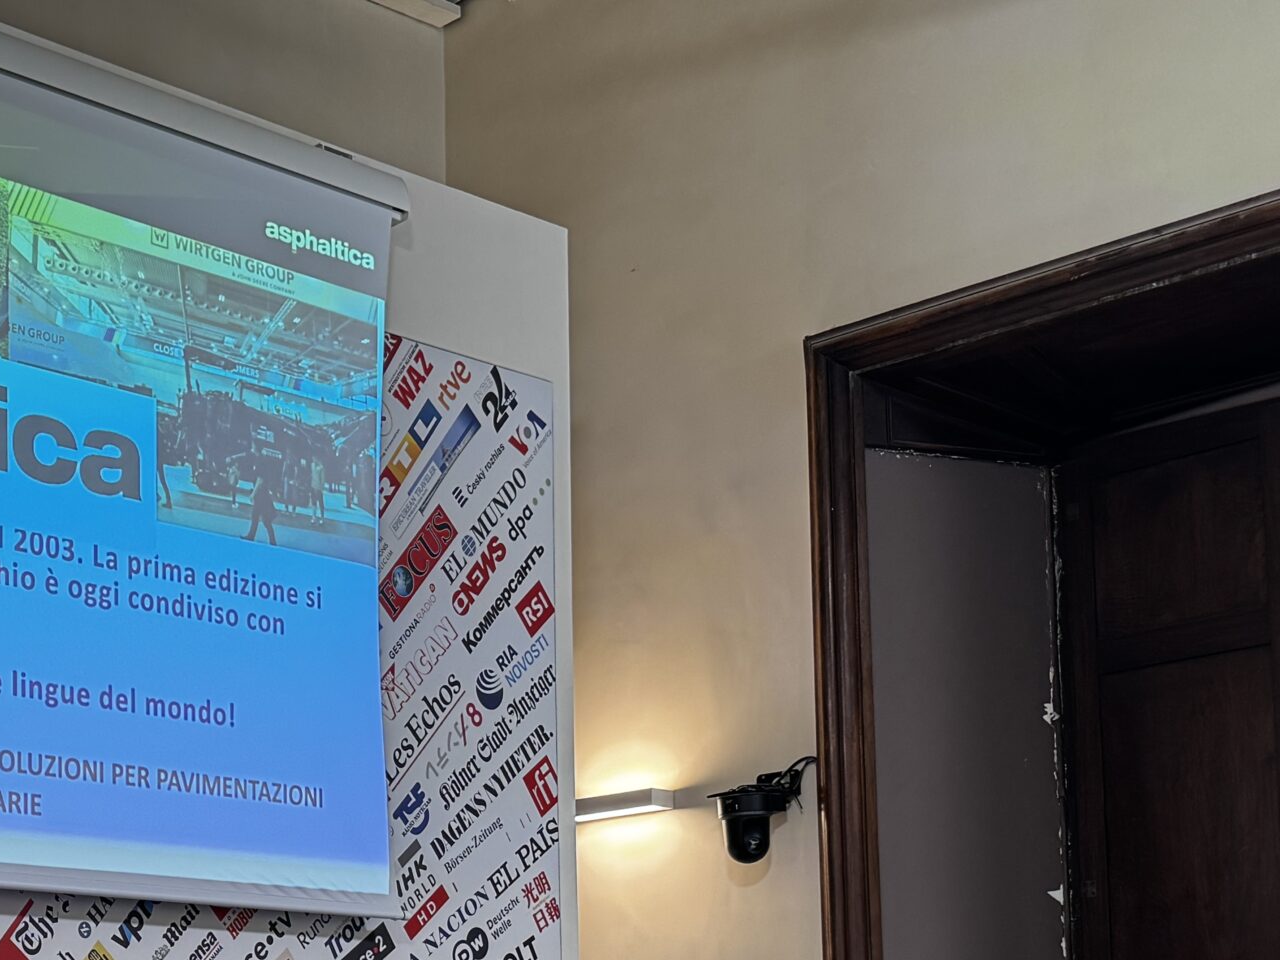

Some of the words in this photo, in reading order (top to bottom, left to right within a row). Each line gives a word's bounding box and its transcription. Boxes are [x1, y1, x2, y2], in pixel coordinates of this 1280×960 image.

[174, 236, 242, 267] WIRTGEN
[245, 257, 295, 285] GROUP
[265, 221, 375, 270] asphaltica
[392, 349, 434, 410] WAZ
[437, 360, 472, 411] rtve
[14, 528, 83, 565] 2003.
[93, 544, 118, 570] La
[128, 554, 196, 586] prima
[204, 568, 298, 605] edizione
[305, 586, 322, 610] si
[45, 567, 59, 595] è
[68, 579, 120, 611] oggi
[128, 589, 239, 627] condiviso
[246, 612, 285, 635] con
[461, 545, 545, 655] Коммерсантъ
[495, 644, 518, 672] RIA
[505, 634, 550, 687] NOVOSTI
[12, 670, 91, 708] lingue
[99, 684, 136, 714] del
[145, 695, 236, 728] mondo!
[111, 762, 150, 790] PER
[157, 768, 324, 809] PAVIMENTAZIONI
[429, 792, 488, 861] DAGENS
[487, 861, 521, 900] EL
[515, 817, 559, 873] PAÍS
[163, 902, 201, 951] Mail
[422, 887, 490, 956] NACION
[486, 896, 521, 930] Deutsche
[490, 918, 513, 941] Welle
